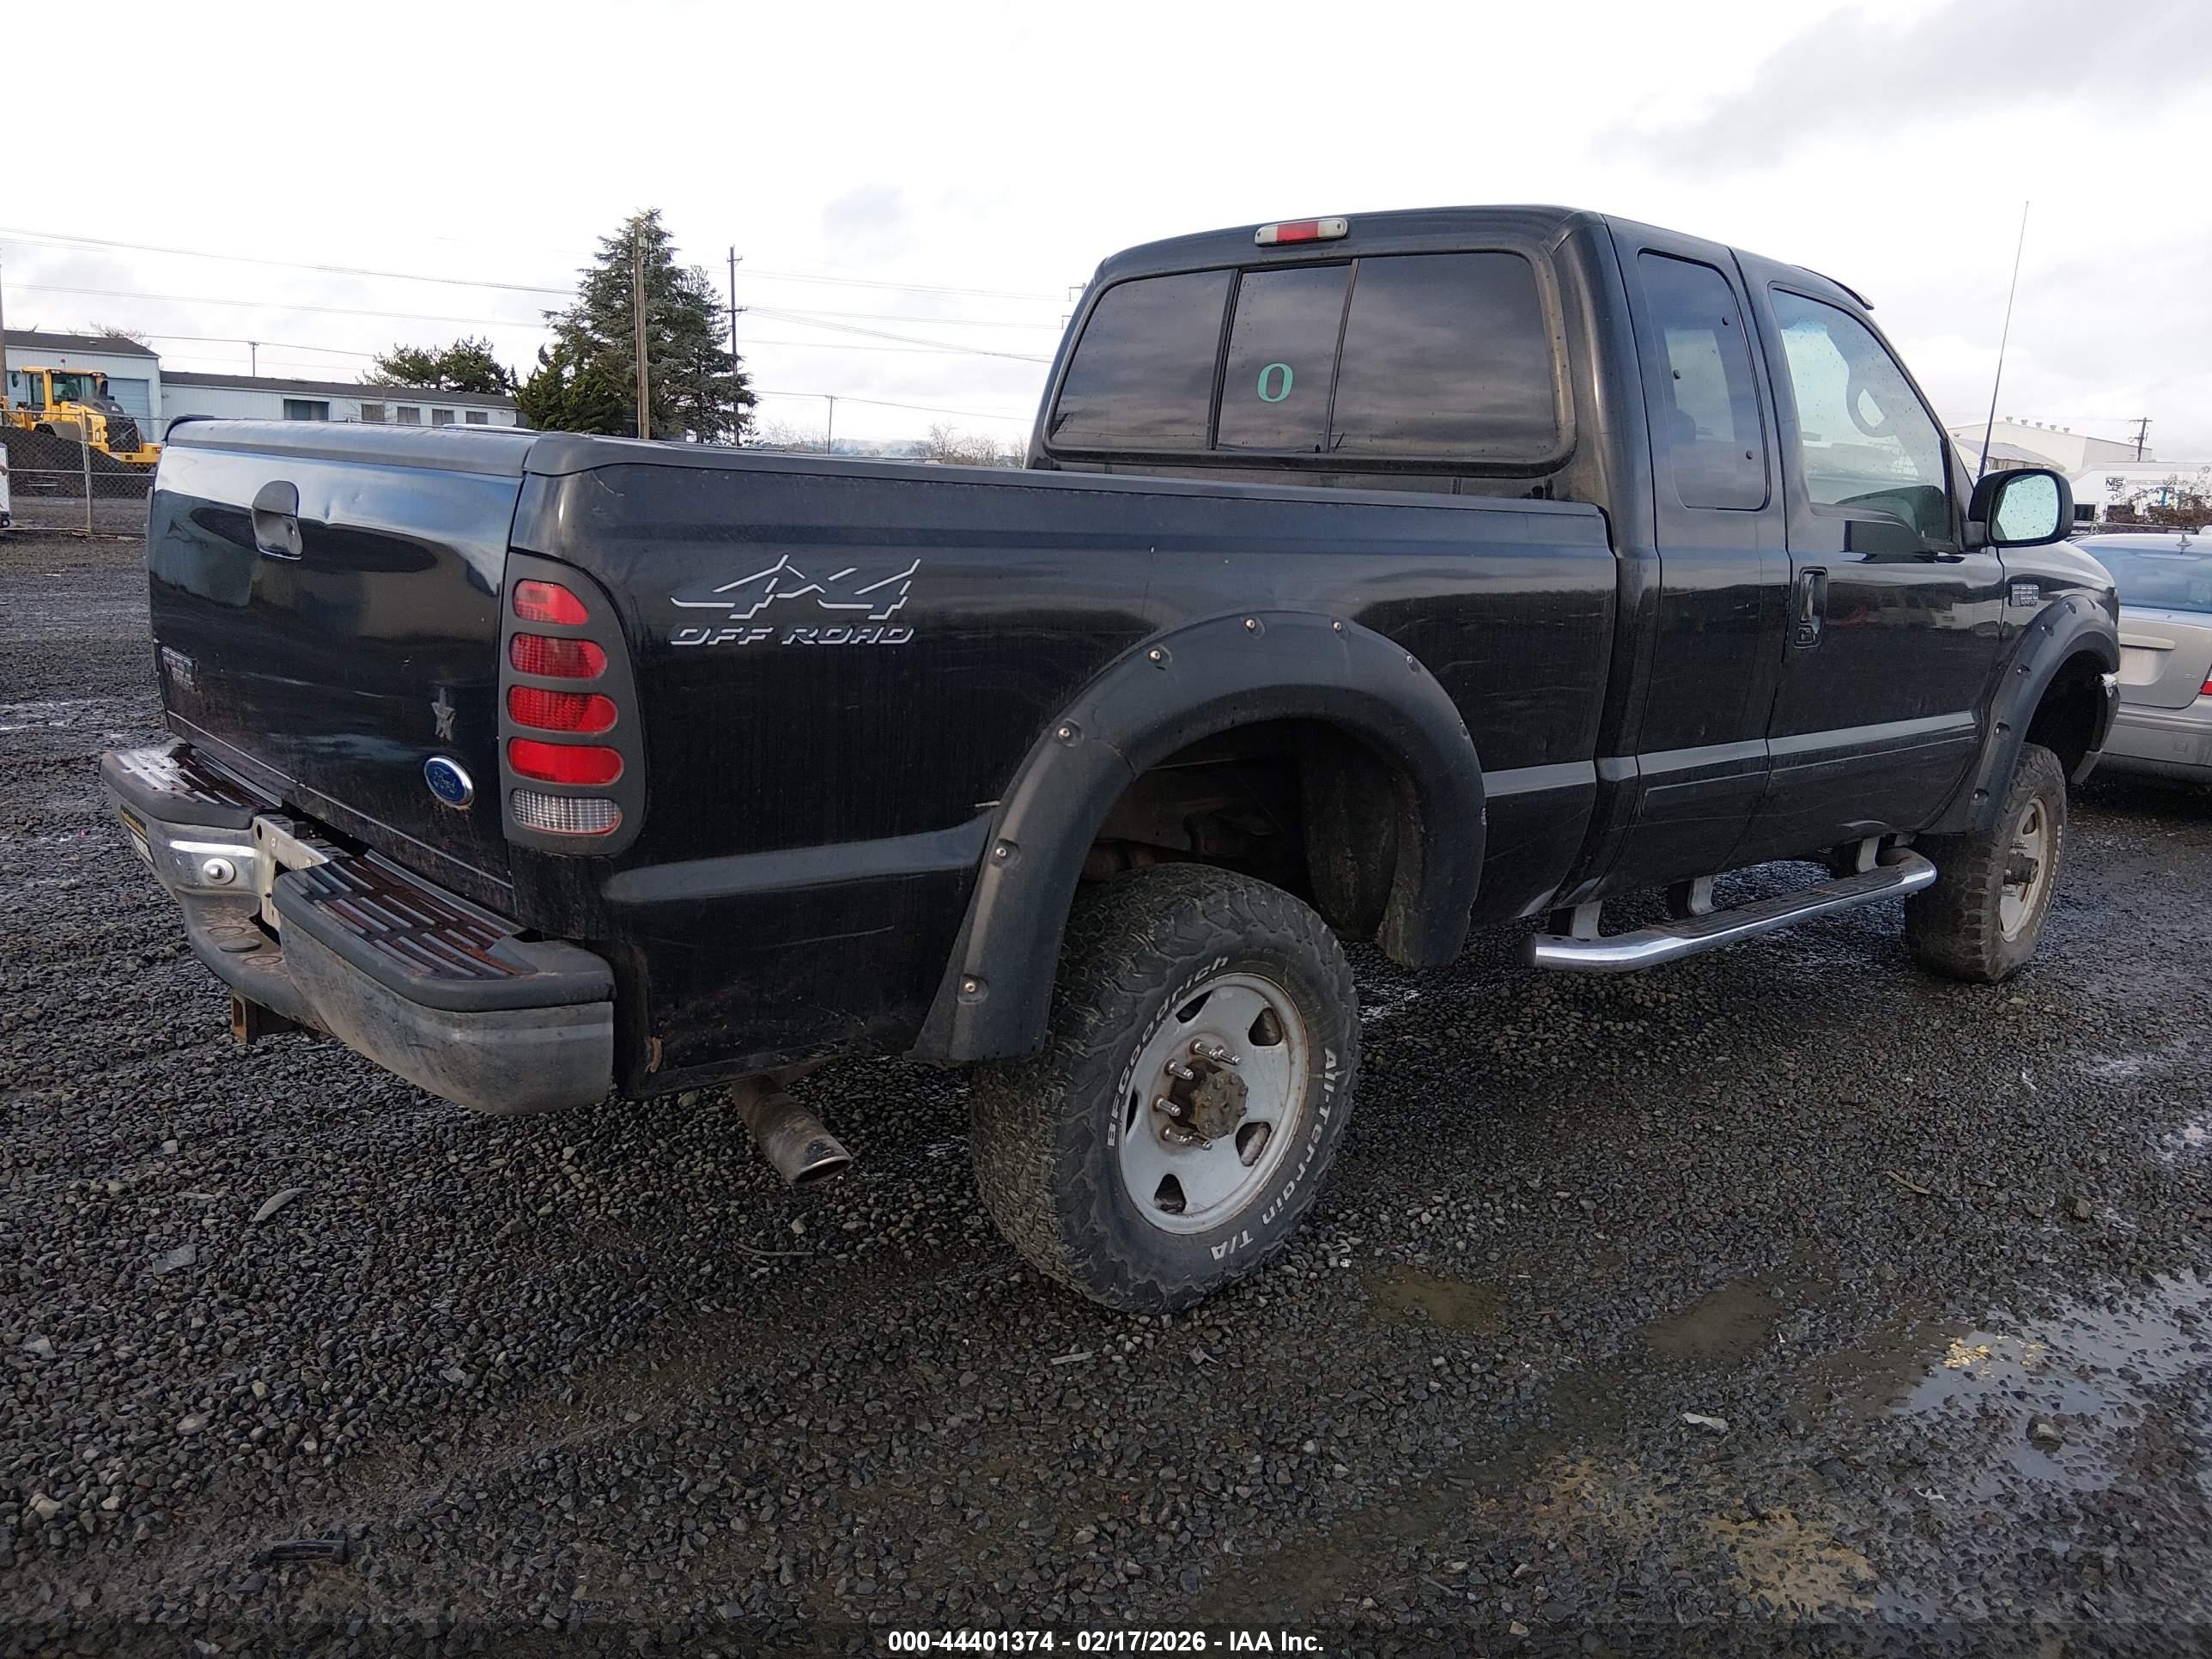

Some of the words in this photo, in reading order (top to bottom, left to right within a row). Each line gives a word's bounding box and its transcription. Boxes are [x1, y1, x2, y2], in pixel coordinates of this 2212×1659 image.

[670, 627, 774, 645] OFF
[781, 627, 915, 645] ROAD
[1107, 956, 1229, 1147] BFGoodrich
[1261, 1048, 1337, 1224] All-Terrain
[1211, 1230, 1254, 1261] T/A
